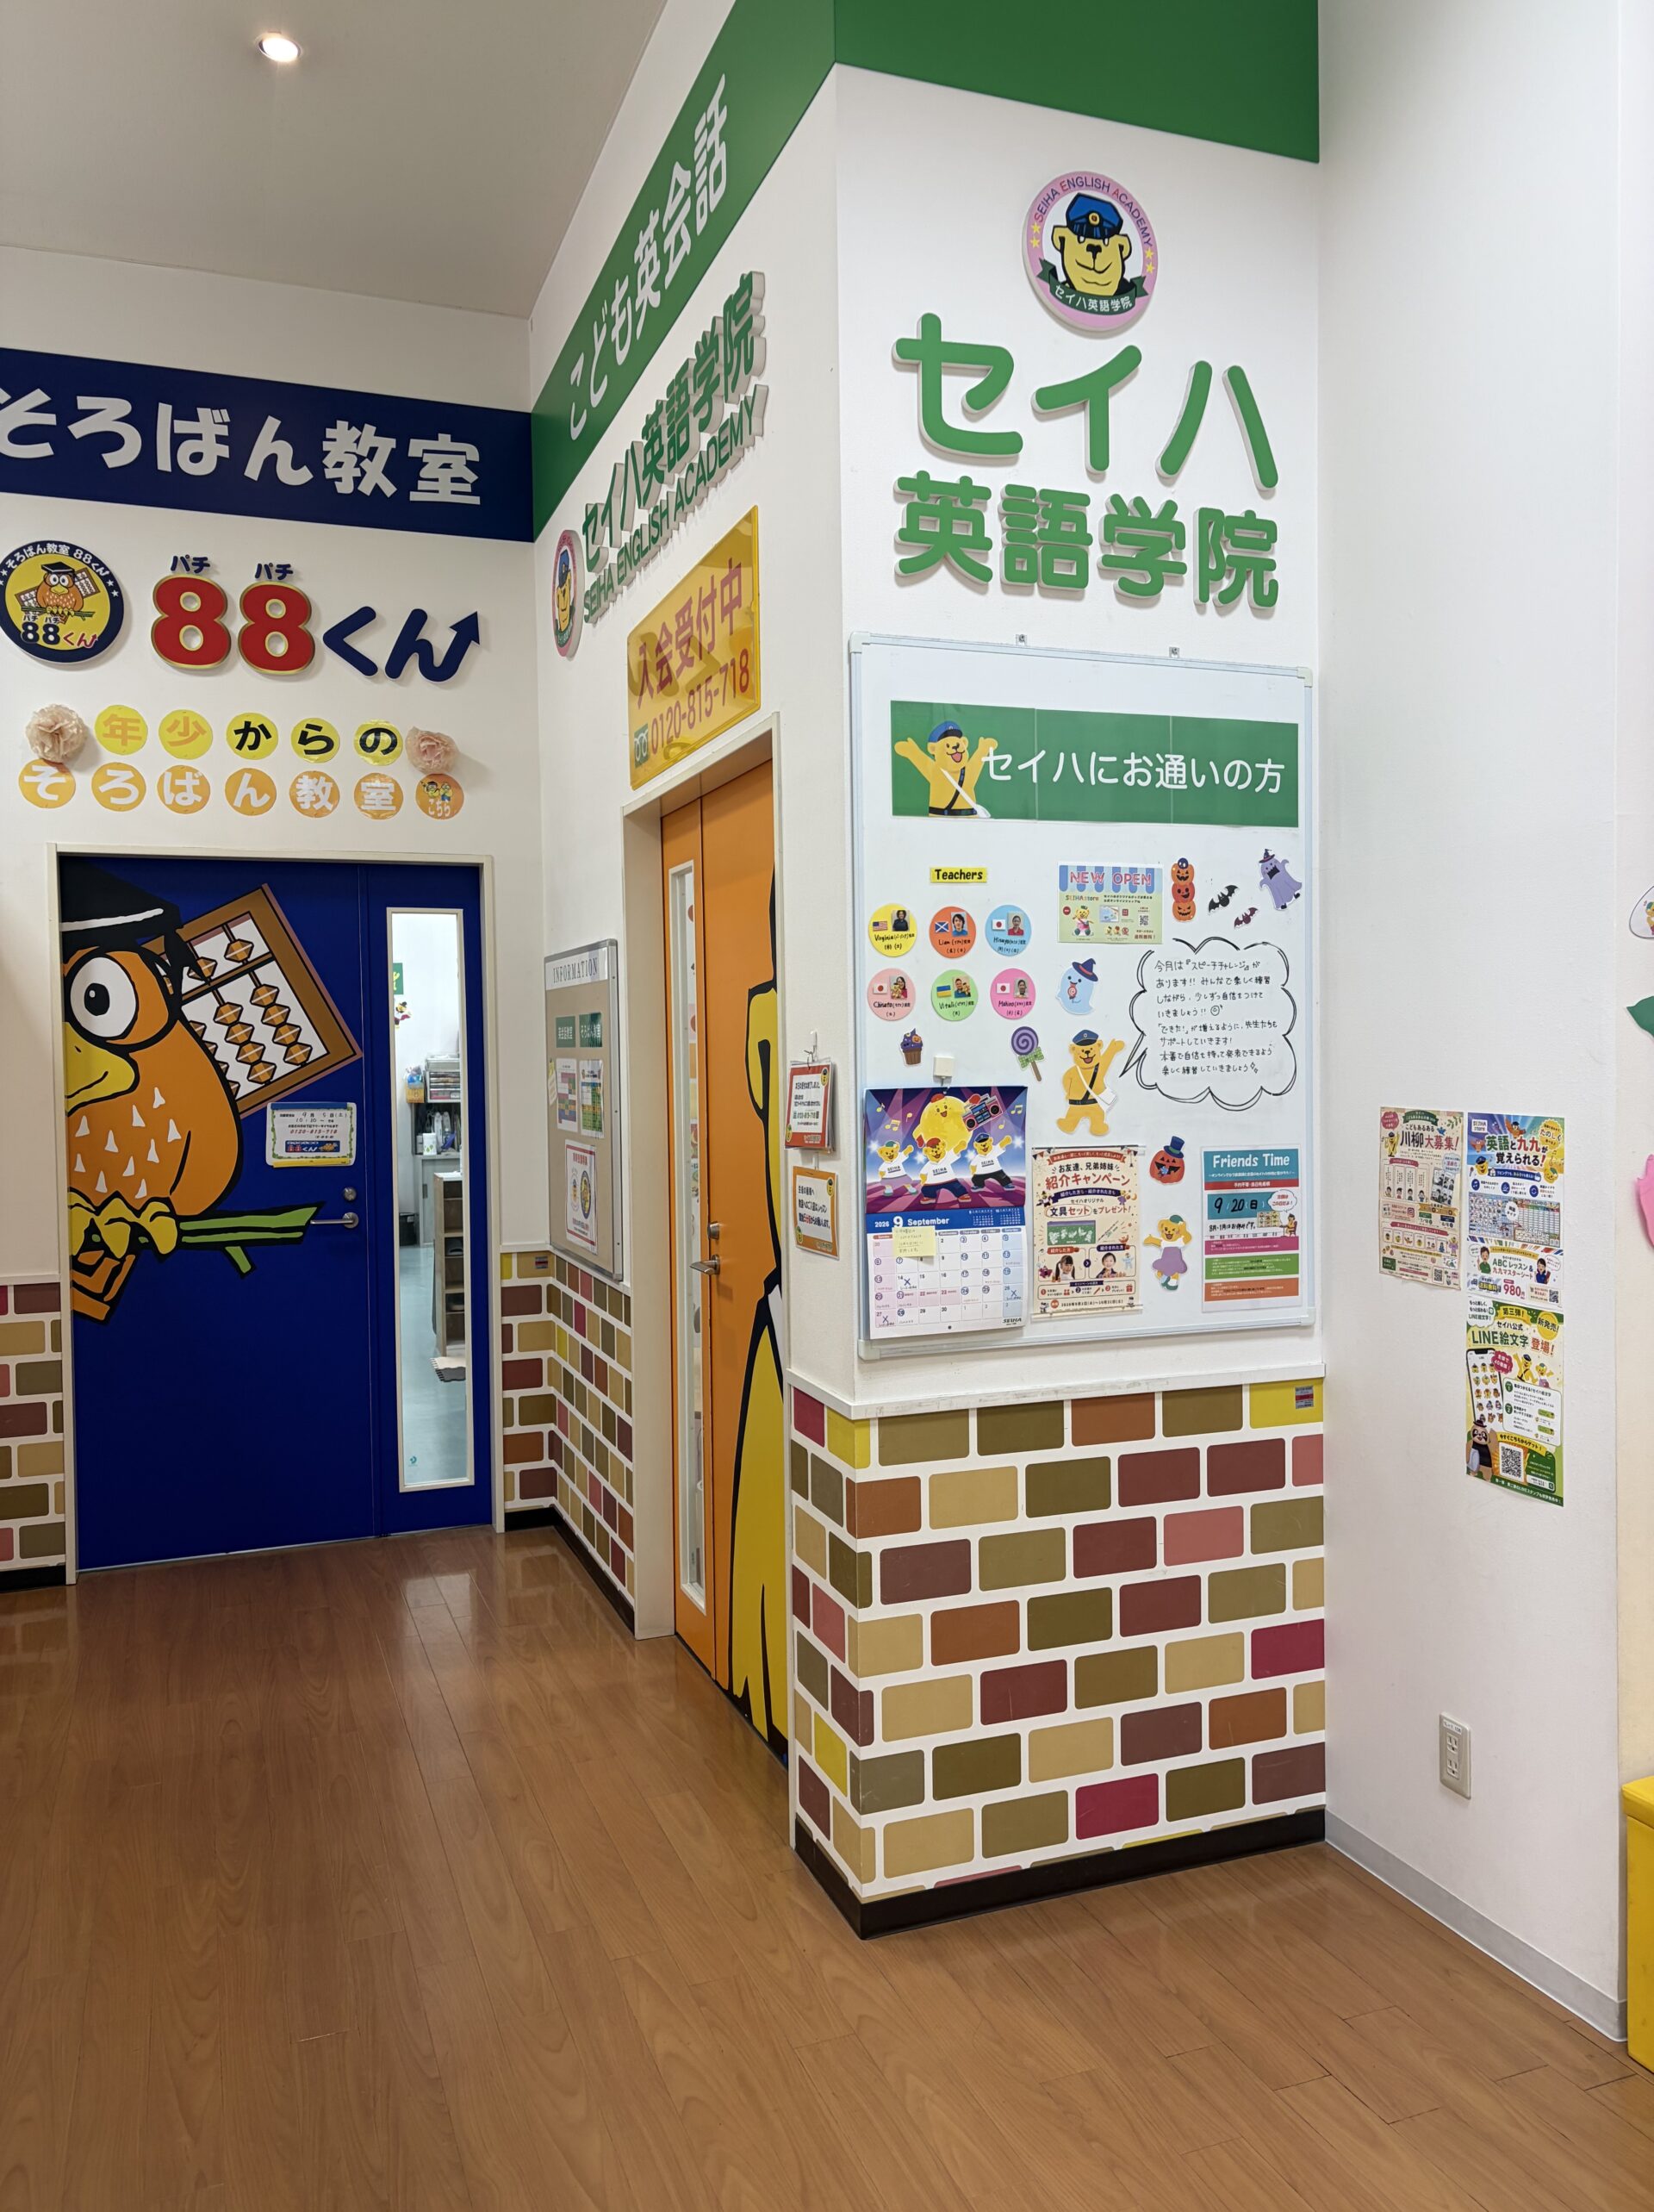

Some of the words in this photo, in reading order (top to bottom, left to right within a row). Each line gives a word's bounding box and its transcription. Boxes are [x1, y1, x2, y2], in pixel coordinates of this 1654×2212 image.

[1034, 188, 1060, 223] SEIHA
[1060, 176, 1111, 193] ENGLISH
[1112, 188, 1153, 247] ACADEMY
[570, 73, 727, 441] こども英会話
[1054, 284, 1133, 312] セイハ英語学院
[892, 313, 1278, 490] セイハ
[582, 271, 762, 574] セイハ英語学院
[0, 388, 481, 505] そろばん教室
[584, 564, 615, 624] SEIHA
[617, 499, 671, 587] ENGLISH
[674, 385, 762, 522] ACADEMY
[893, 470, 1278, 609] 英語学院
[5, 543, 71, 569] そろばん教室
[170, 555, 211, 575] パチ
[254, 563, 294, 582] パチ
[637, 558, 743, 709] 入会受付中
[650, 648, 750, 756] 0120-815-718
[103, 712, 398, 756] 年少からの
[981, 746, 1285, 794] セイハにお通いの方
[23, 763, 397, 813] そろばん教室
[935, 869, 983, 881] Teachers
[1070, 871, 1104, 884] NEW
[1113, 872, 1151, 886] OPEN
[553, 957, 598, 984] INFORMATION
[1400, 1131, 1459, 1151] 川柳大募集!
[1486, 1135, 1548, 1153] 英語と九九が
[1059, 1162, 1114, 1173] お友達、兄弟姉妹
[1213, 1153, 1259, 1168] Friends
[1262, 1153, 1290, 1167] Time
[1496, 1152, 1546, 1167] 覚えられる!
[1045, 1173, 1130, 1190] 紹介キャンペーン
[892, 1216, 904, 1227] 9
[907, 1218, 949, 1227] September
[1492, 1267, 1533, 1280] 九九マスターシート
[1497, 1321, 1523, 1331] セイハ公式
[1538, 1317, 1559, 1333] 新発売!
[1471, 1330, 1529, 1348] LINE絵文字
[1532, 1337, 1555, 1356] 登場!
